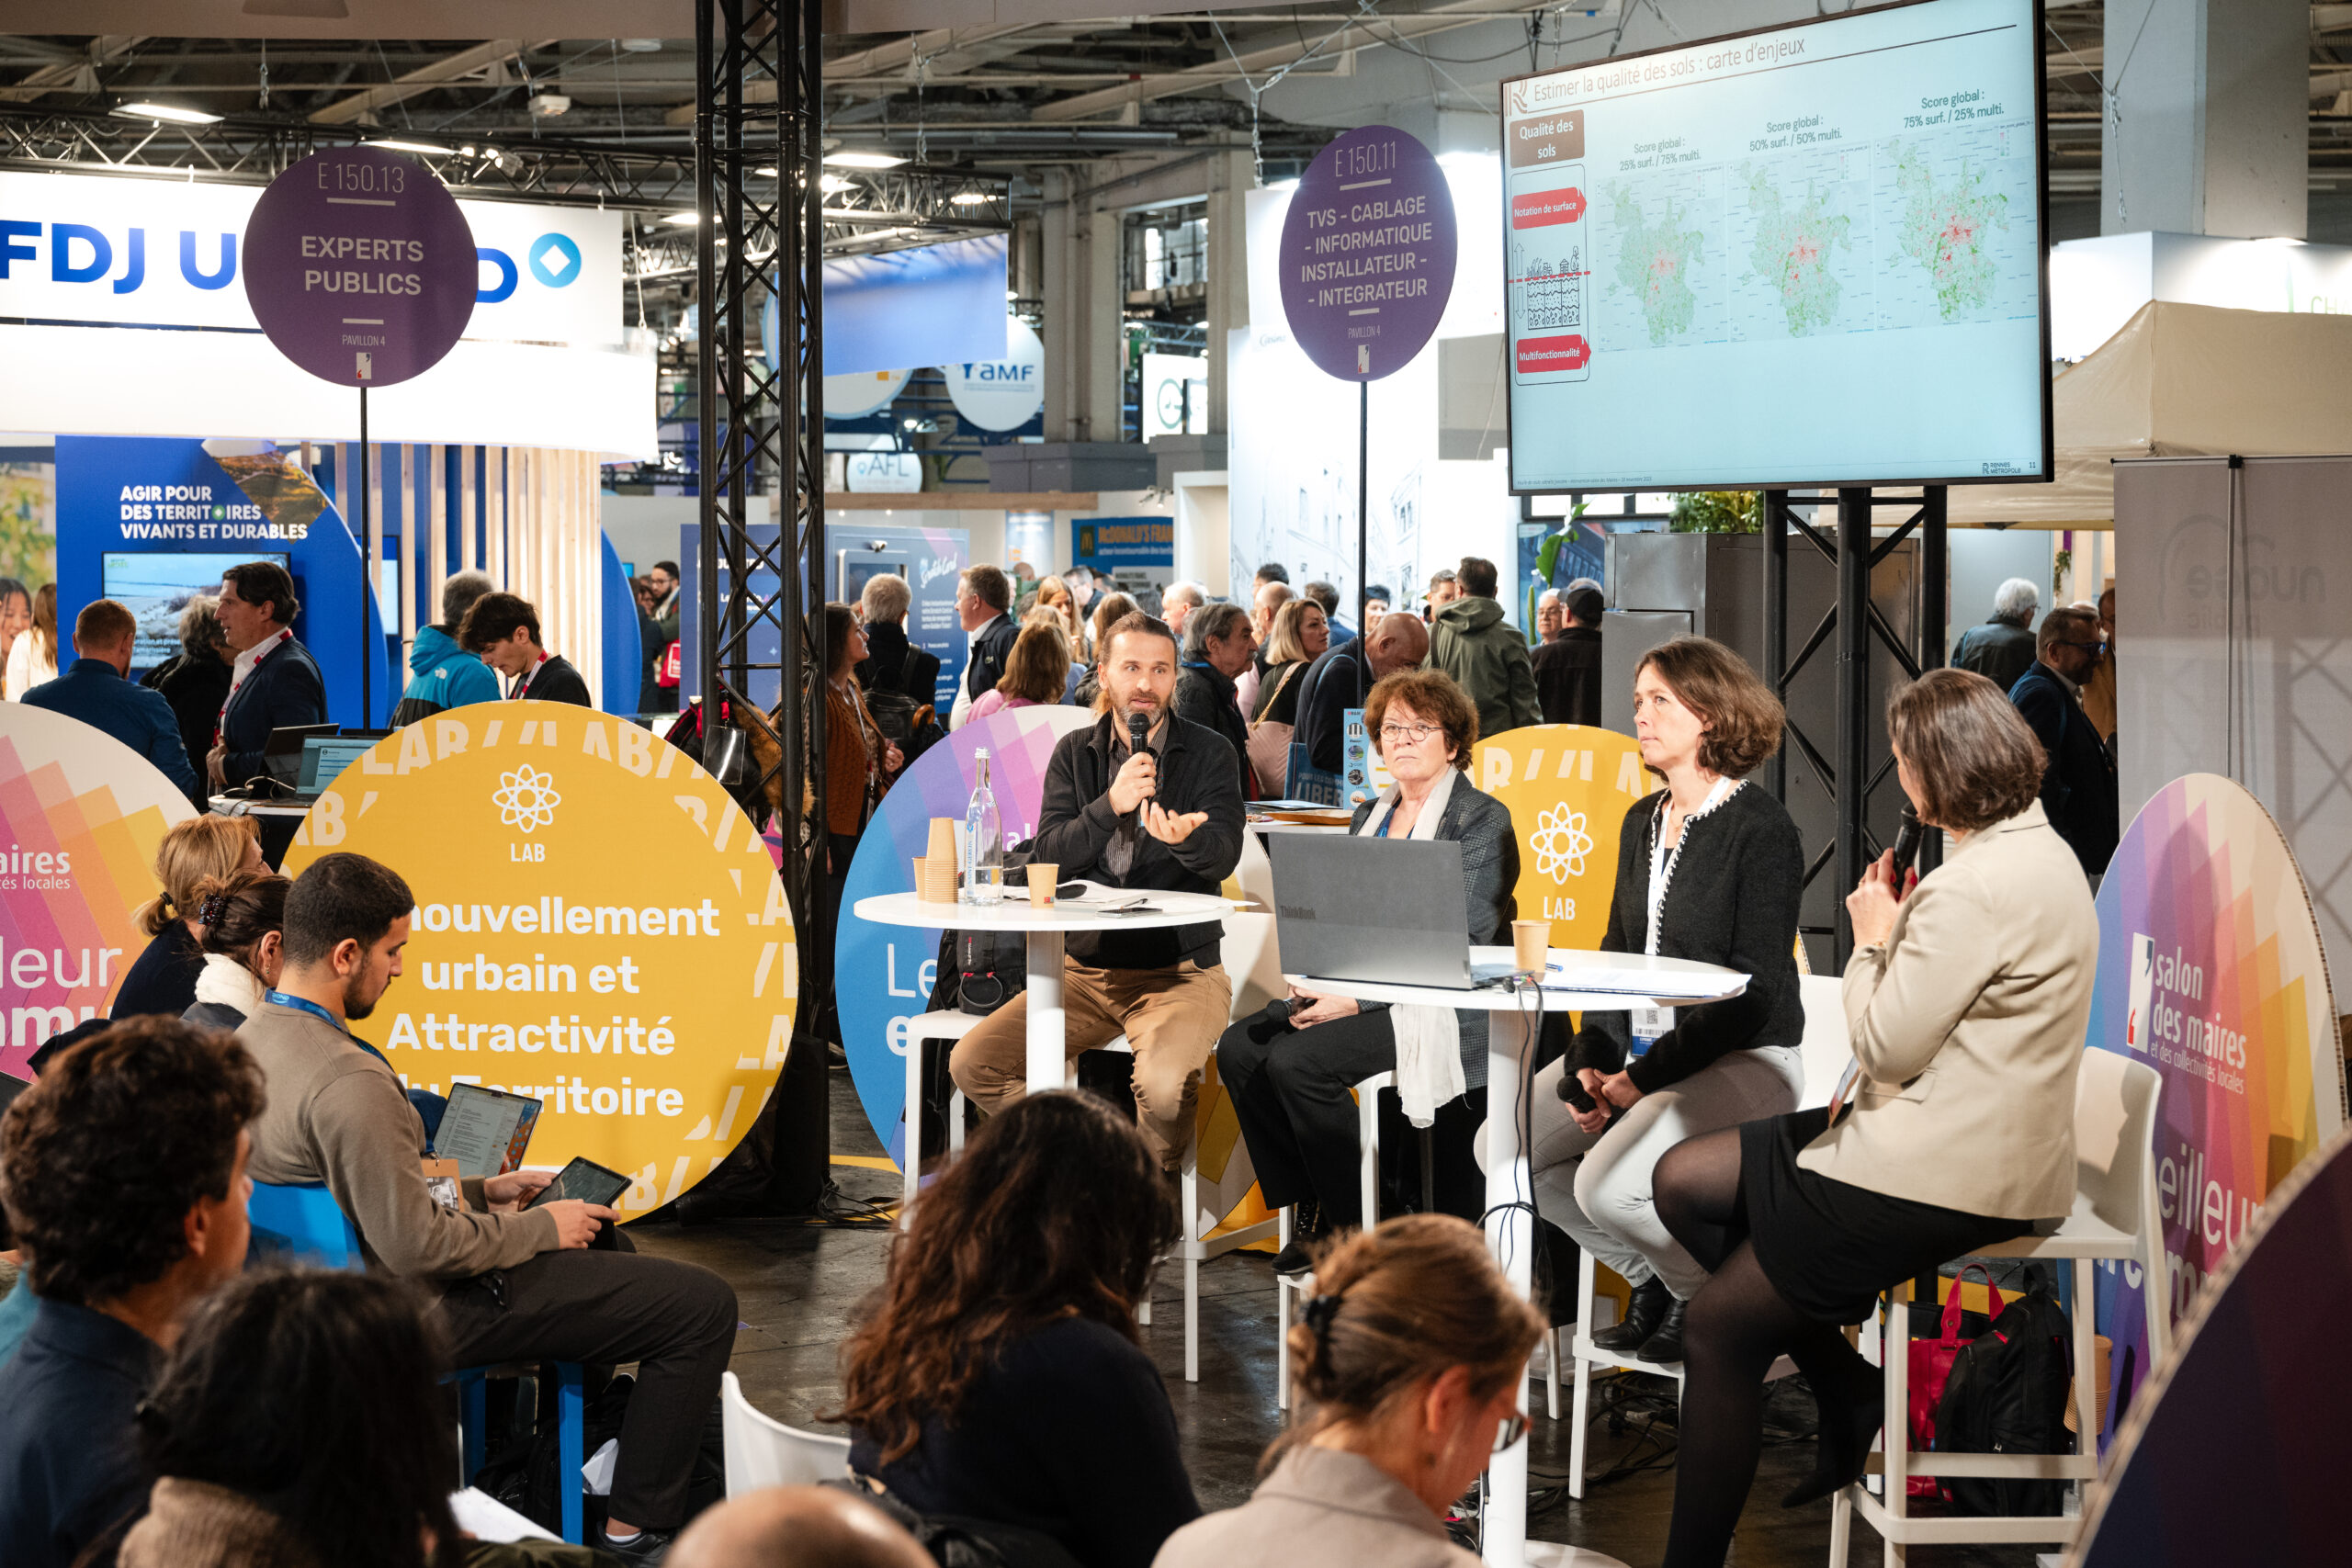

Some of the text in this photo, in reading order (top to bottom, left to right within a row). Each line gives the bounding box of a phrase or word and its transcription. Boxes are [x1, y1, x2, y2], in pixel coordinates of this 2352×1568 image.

[1534, 75, 1582, 102] Estimer
[1583, 72, 1593, 94] la
[1597, 65, 1640, 92] qualité
[1645, 61, 1667, 82] des
[1670, 55, 1694, 77] sols
[1707, 49, 1741, 70] carte
[1921, 96, 1949, 110] Score
[1951, 89, 1979, 107] global
[1766, 119, 1791, 134] Score
[1792, 115, 1819, 132] global
[1904, 115, 1924, 130] 75%
[1926, 110, 1946, 126] surf.
[1955, 106, 1975, 121] 25%
[1977, 102, 2005, 118] multi.
[1520, 118, 1574, 141] Qualité des
[1749, 139, 1769, 152] 50%
[1770, 135, 1789, 149] surf.
[1795, 130, 1815, 146] 50%
[1817, 126, 1842, 141] multi.
[1335, 141, 1396, 177] E 150.11
[1537, 142, 1556, 160] sols
[1634, 141, 1655, 154] Score
[1657, 138, 1681, 154] global
[1620, 158, 1635, 172] 25%
[1637, 155, 1654, 169] surf.
[1661, 152, 1678, 166] 75%
[1679, 150, 1702, 164] multi.
[318, 163, 404, 194] E 150.13
[1306, 209, 1336, 229] TVS
[1351, 196, 1426, 223] CABLAGE
[1514, 200, 1577, 218] Notation de surface
[301, 235, 424, 263] EXPERTS
[1316, 222, 1432, 254] INFORMATIQUE
[0, 219, 145, 295] FDJ
[1301, 252, 1416, 283] INSTALLATEUR
[305, 270, 422, 296] PUBLICS
[1319, 278, 1428, 307] INTEGRATEUR
[342, 334, 386, 346] PAVILLON 4
[1348, 325, 1380, 339] PAVILLON 4
[1519, 346, 1580, 362] Multifonctionnalité
[120, 485, 212, 502] AGIR POUR
[121, 504, 153, 521] DES
[120, 524, 308, 540] VIVANTS ET DURABLES
[511, 842, 546, 863] LAB
[23, 874, 71, 890] locales
[1544, 897, 1576, 920] LAB
[422, 953, 639, 994] urbain et
[2155, 946, 2203, 1001] salon
[386, 1013, 675, 1055] Attractivité
[2154, 990, 2247, 1070] des maires
[2150, 1042, 2244, 1095] et des collectivités locales
